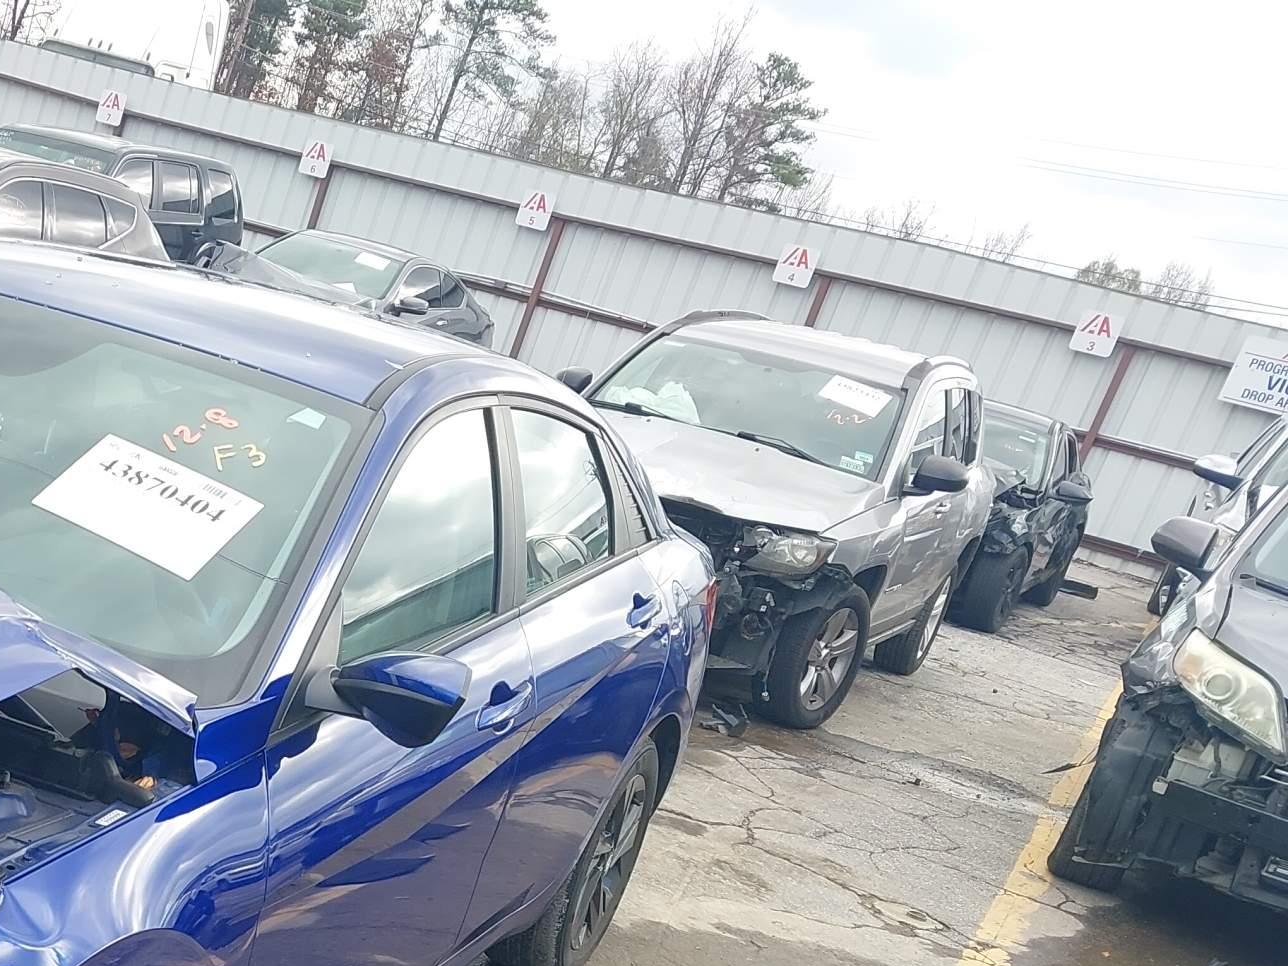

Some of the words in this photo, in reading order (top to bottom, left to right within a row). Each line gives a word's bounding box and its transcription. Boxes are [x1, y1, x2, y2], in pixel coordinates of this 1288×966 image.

[310, 165, 317, 174] 6
[528, 215, 536, 226] 5
[787, 272, 795, 283] 4
[1086, 340, 1096, 352] 3
[1267, 375, 1288, 395] VI
[1240, 387, 1275, 404] DROP
[98, 458, 227, 523] 43870404
